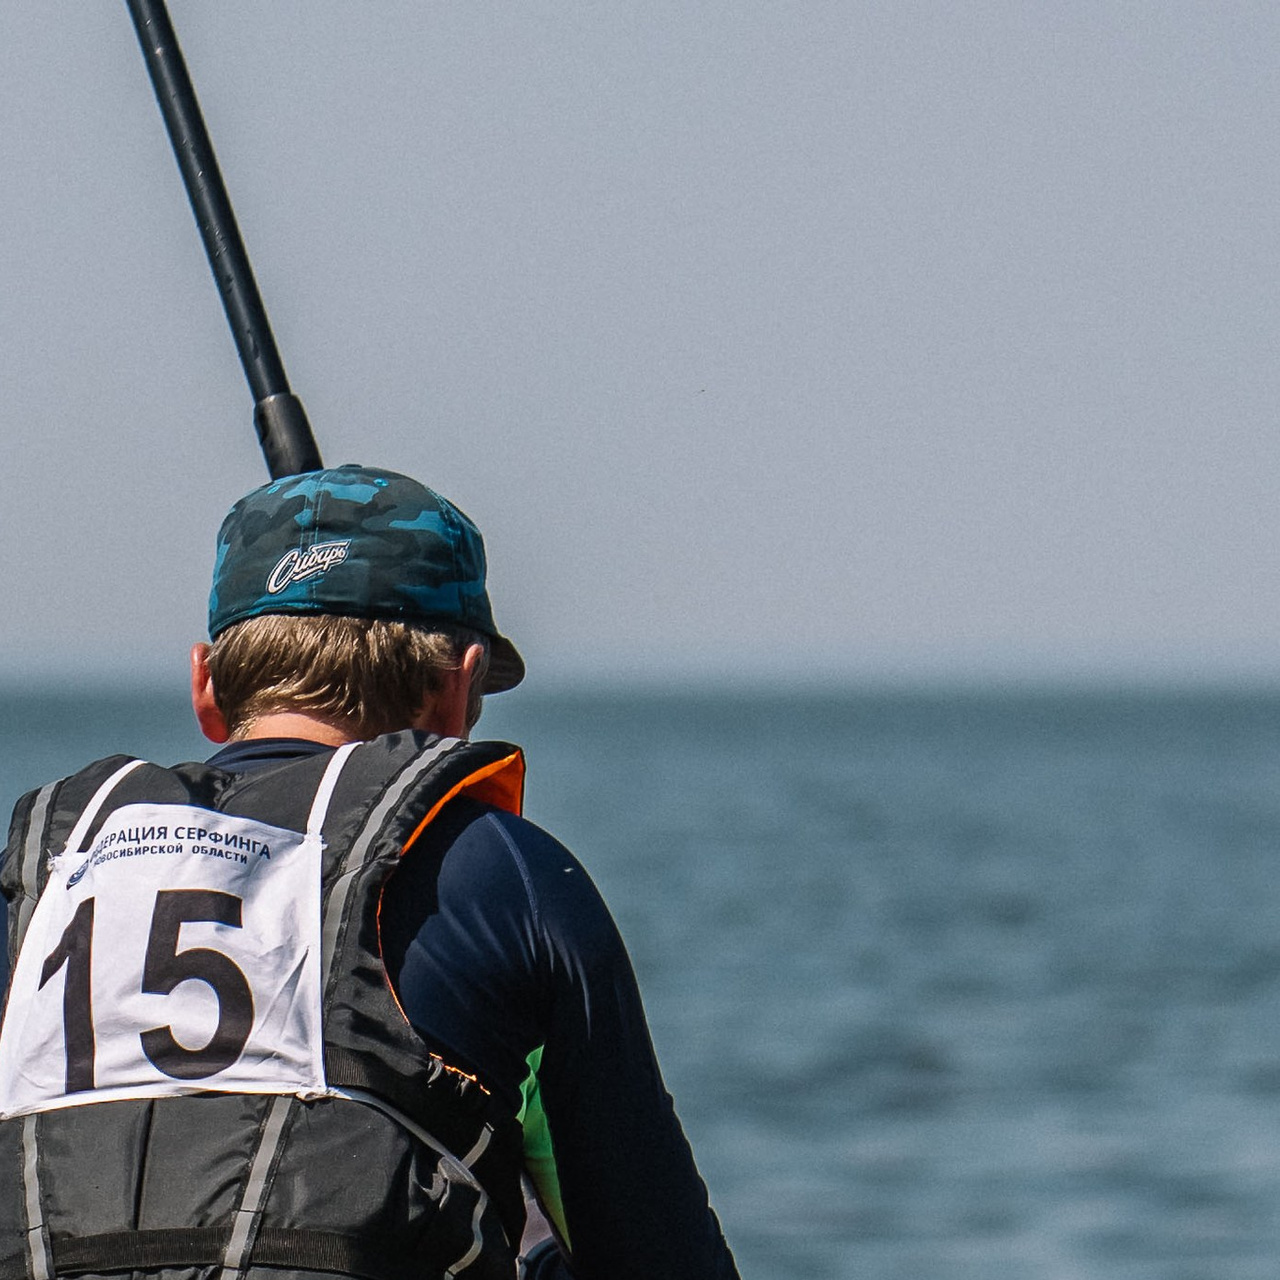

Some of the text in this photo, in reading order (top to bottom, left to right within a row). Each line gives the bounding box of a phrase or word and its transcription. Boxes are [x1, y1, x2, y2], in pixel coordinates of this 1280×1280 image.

[174, 826, 271, 860] СЕРФИНГА
[192, 845, 248, 865] ОБЛАСТИ
[38, 888, 256, 1095] 15
